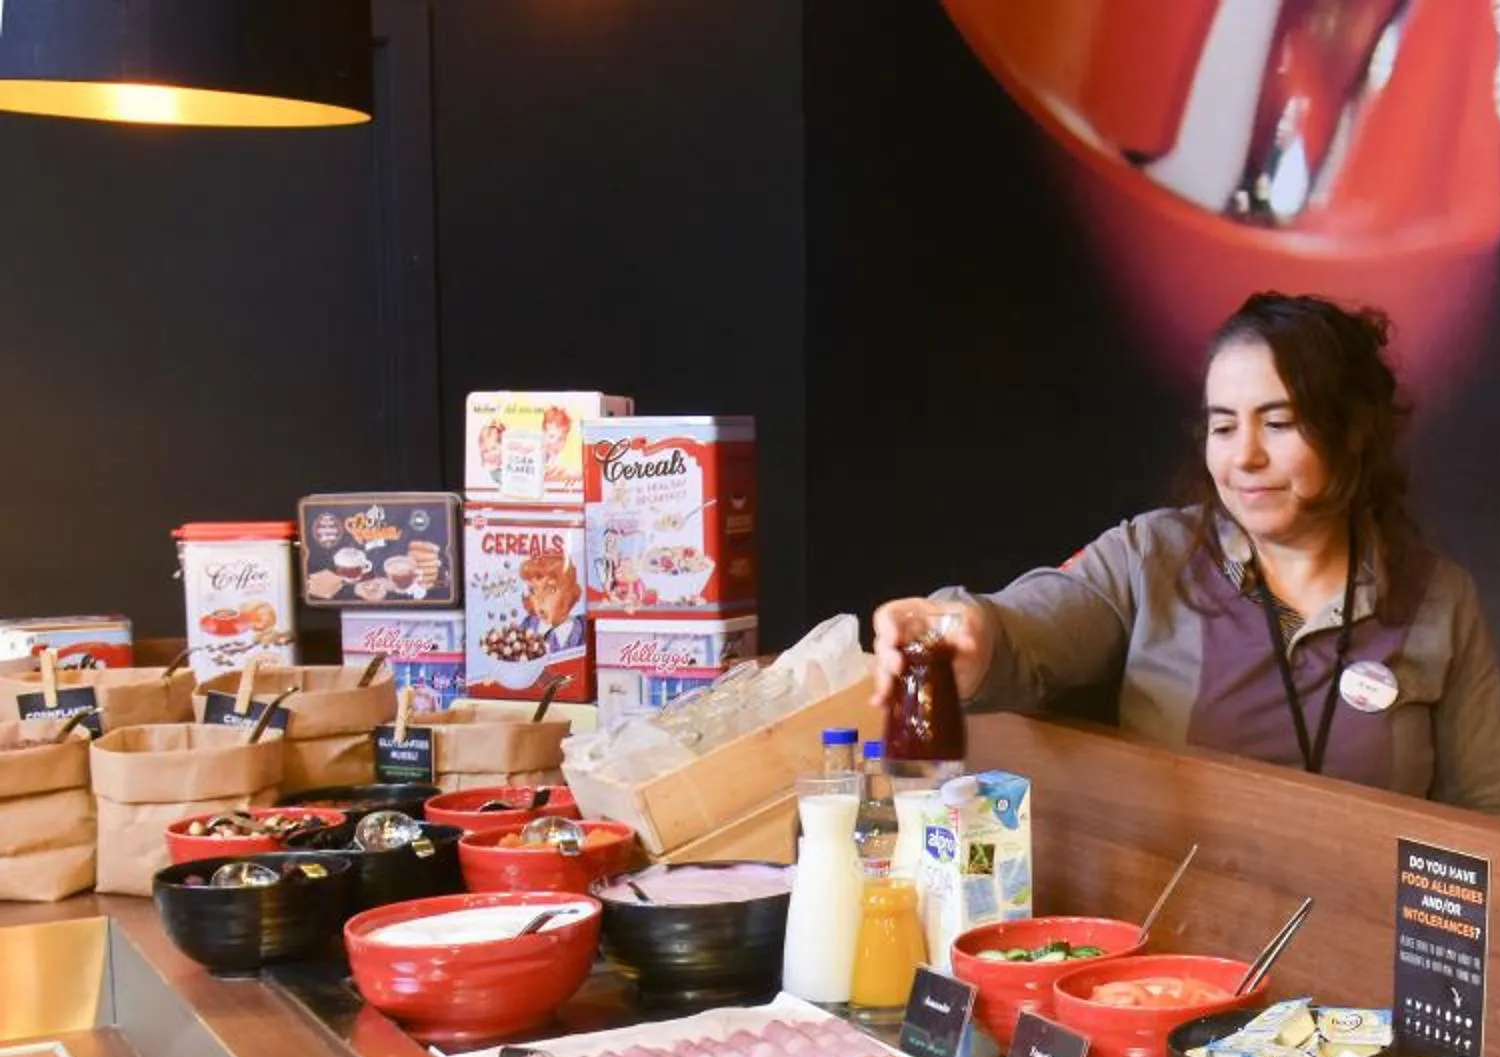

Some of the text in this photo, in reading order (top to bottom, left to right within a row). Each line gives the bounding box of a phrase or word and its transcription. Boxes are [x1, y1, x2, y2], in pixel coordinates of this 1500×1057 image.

[594, 438, 687, 482] Cereals
[481, 532, 565, 560] CEREALS
[205, 562, 268, 591] Coffee
[1409, 855, 1477, 885] DO YOU HAVE
[1402, 872, 1483, 905] FOOD ALLERGIES
[1421, 895, 1461, 916] AND/OR
[1403, 907, 1481, 940] INTOLERANCES?
